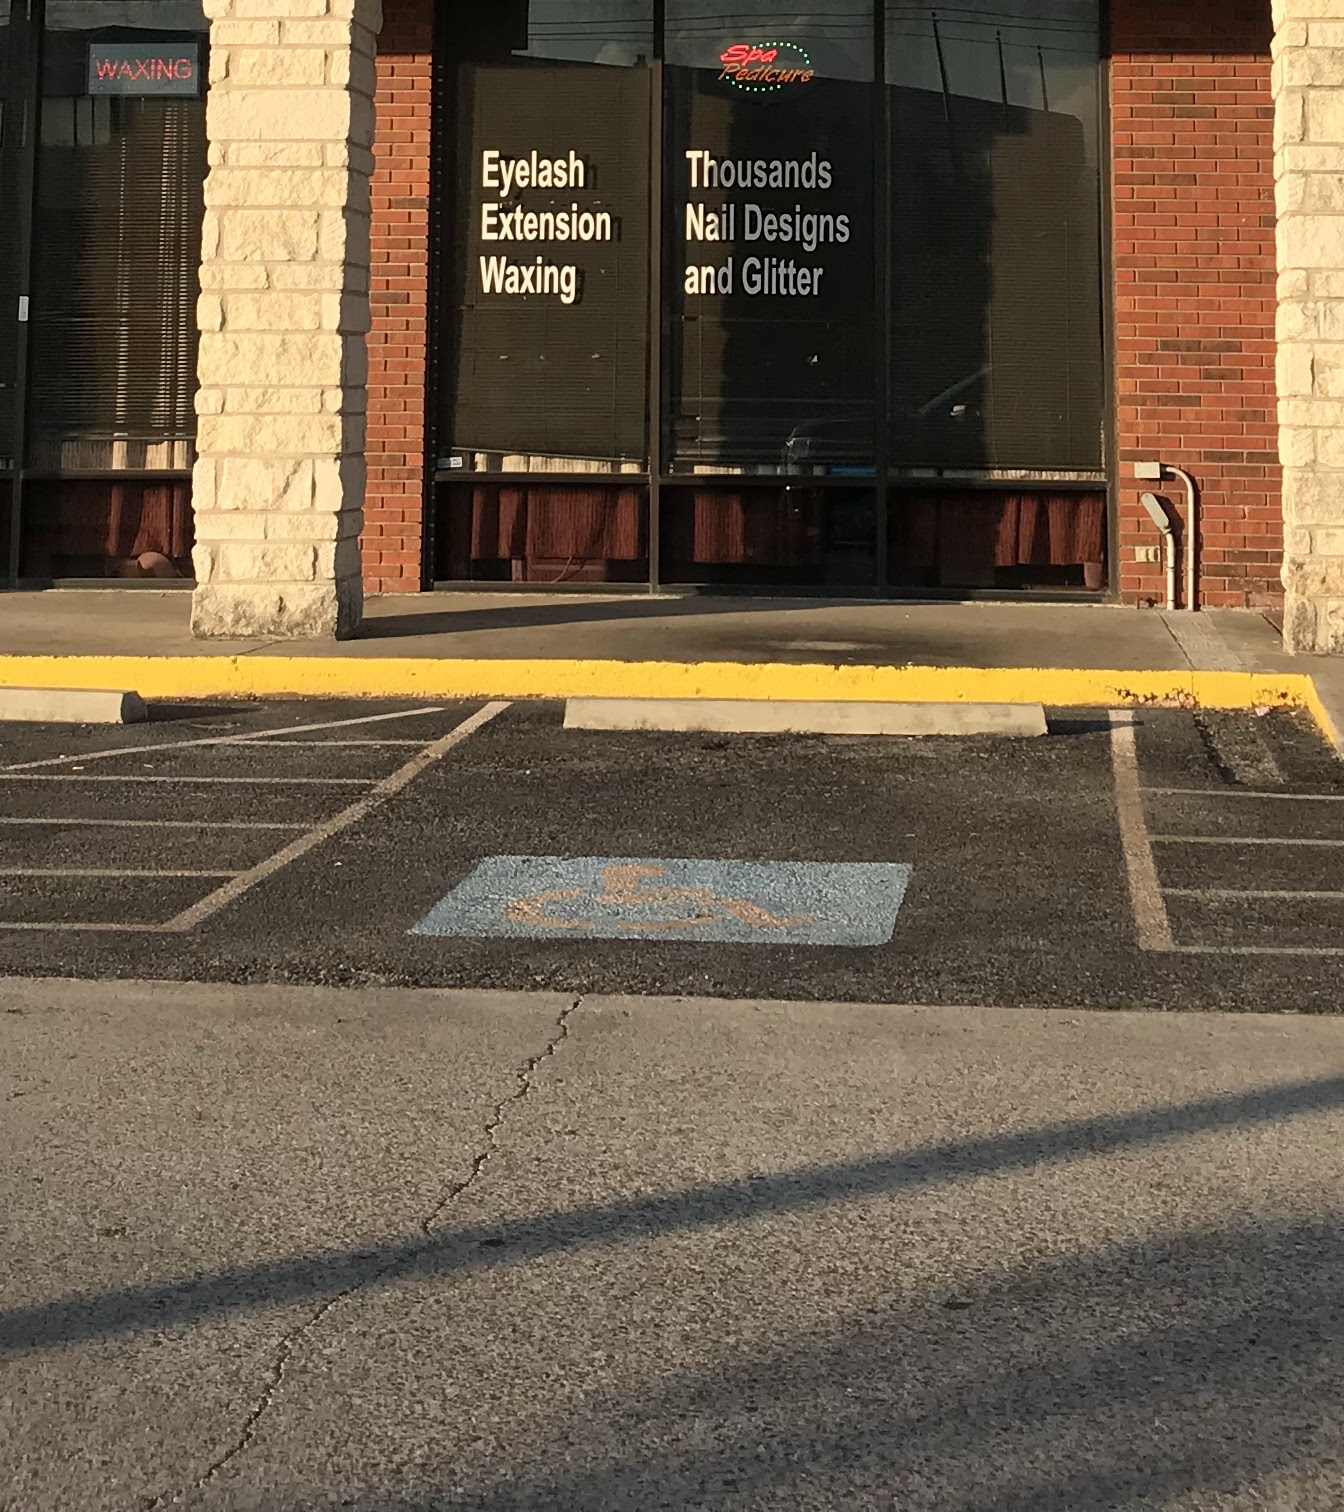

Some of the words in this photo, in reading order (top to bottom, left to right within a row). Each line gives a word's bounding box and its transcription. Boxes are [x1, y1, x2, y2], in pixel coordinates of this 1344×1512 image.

[95, 58, 193, 80] WAXING
[717, 63, 814, 83] Pedicure
[719, 43, 778, 66] Spa
[482, 150, 585, 197] Eyelash
[685, 150, 832, 188] Thousands
[481, 202, 612, 240] Extension
[685, 203, 735, 241] Nail
[744, 203, 850, 252] Designs
[479, 255, 576, 304] Waxing
[684, 256, 733, 294] and
[742, 256, 824, 295] Glitter
